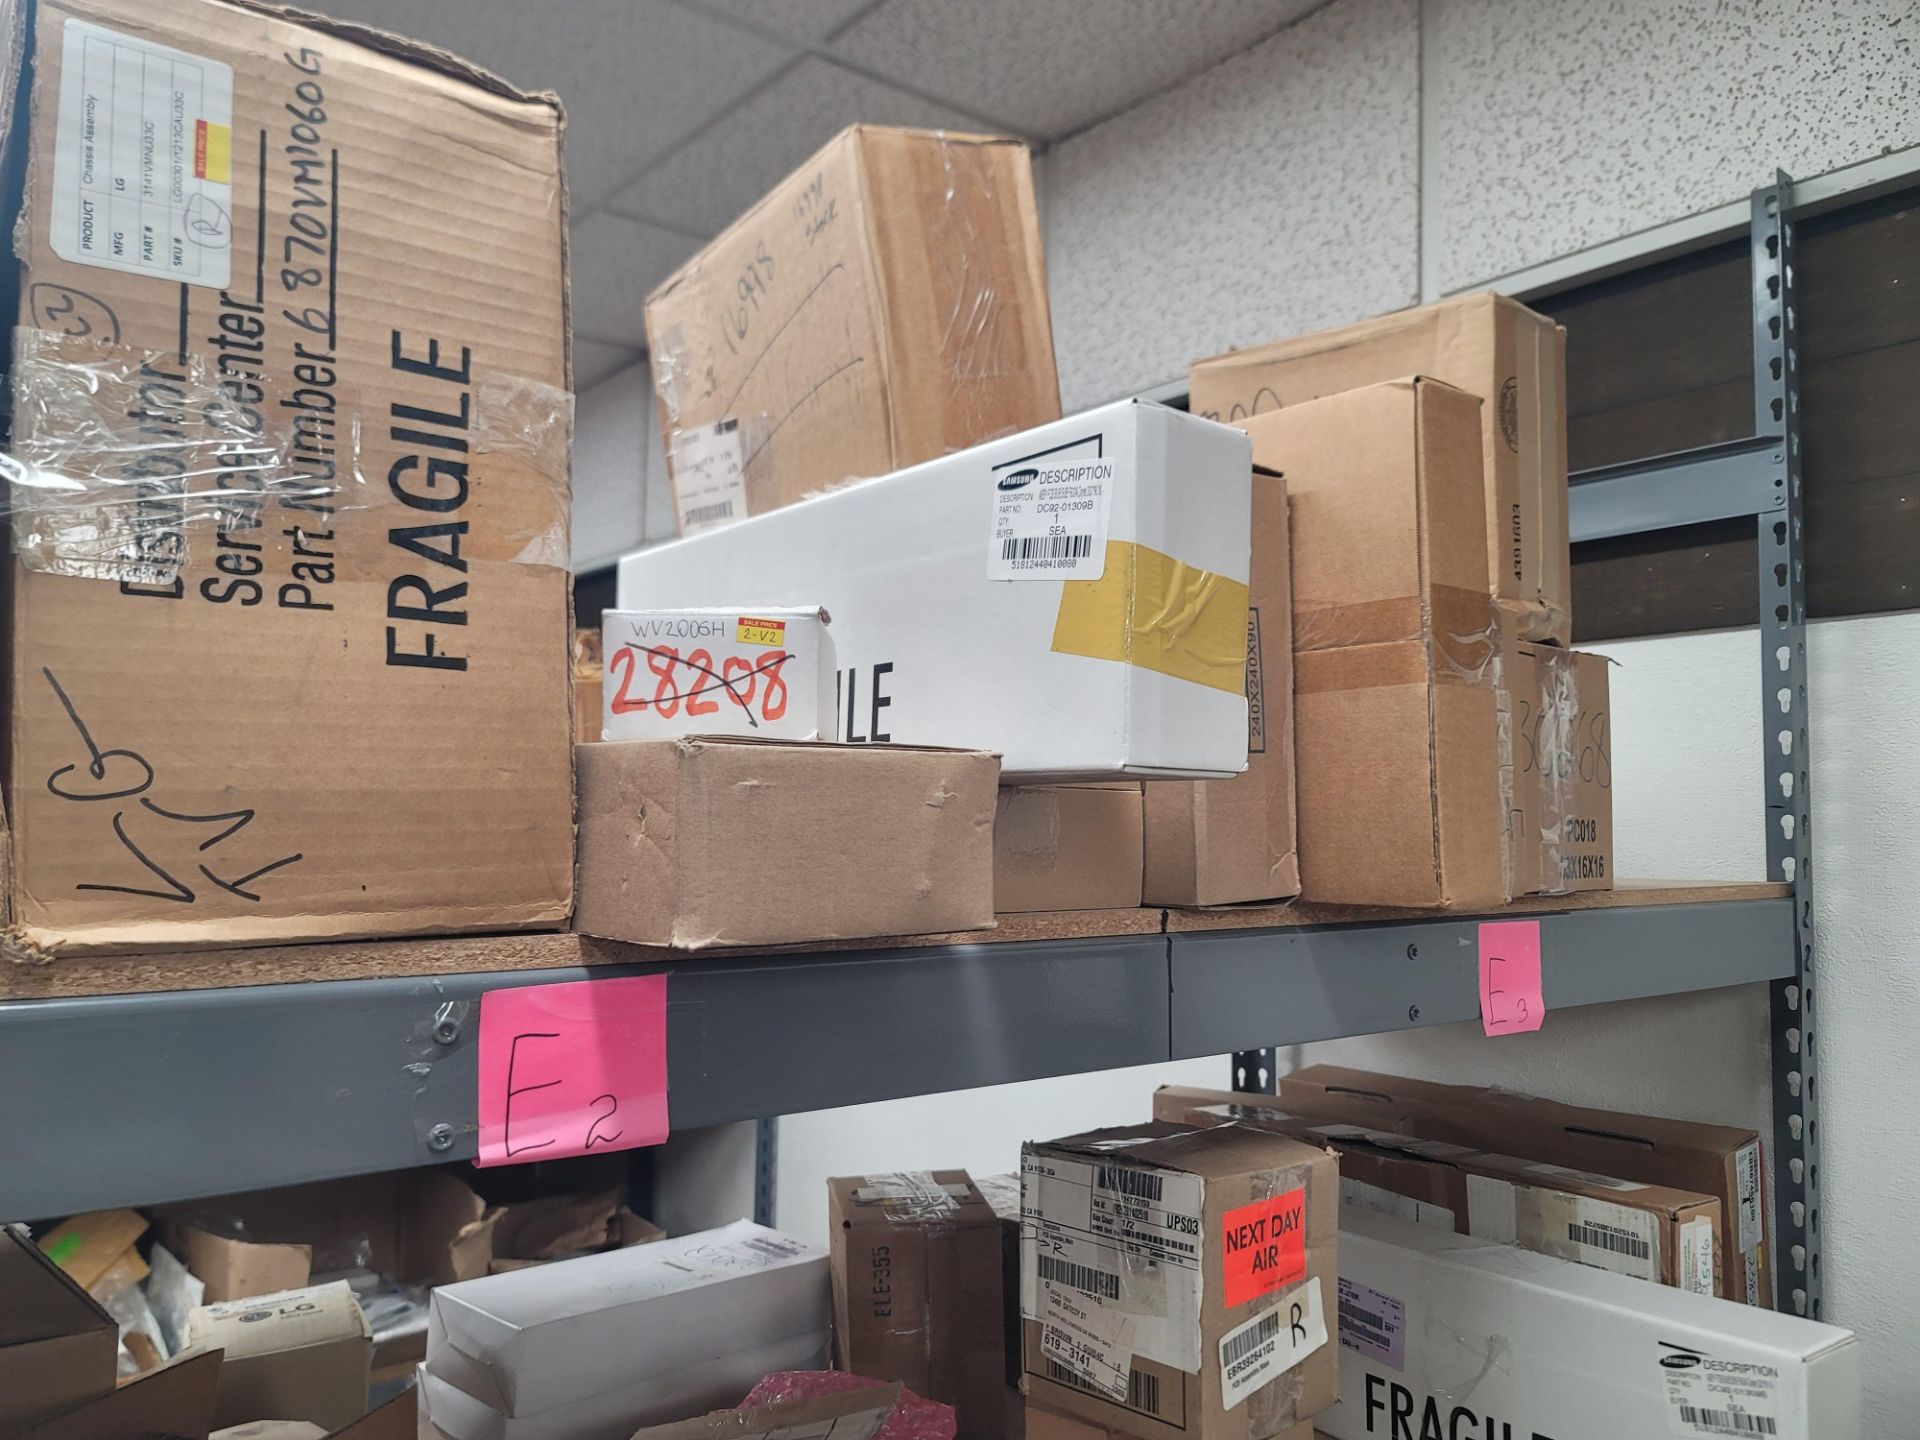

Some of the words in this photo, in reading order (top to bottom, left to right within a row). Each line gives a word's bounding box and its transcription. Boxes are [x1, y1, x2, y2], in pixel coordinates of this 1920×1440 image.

[83, 95, 98, 144] Assembly
[82, 146, 95, 184] Chassis
[114, 177, 126, 192] LG
[83, 200, 95, 250] PRODUCT
[113, 232, 124, 256] MFG
[143, 235, 154, 262] PART
[173, 247, 183, 267] SKU
[203, 291, 266, 436] Center
[280, 342, 337, 514] Number
[1001, 472, 1036, 487] SAMSUNG
[1038, 464, 1113, 485] DESCRIPTION
[386, 329, 471, 671] FRAGILE
[1036, 499, 1094, 514] DC92-01309B
[200, 447, 264, 606] Service
[1048, 525, 1067, 537] SEA
[1053, 513, 1059, 524] 1
[278, 525, 335, 611] Part
[743, 620, 760, 628] SALE
[760, 622, 778, 630] PRICE
[610, 644, 788, 722] 28208
[1247, 621, 1262, 737] 240X240X90
[1567, 819, 1597, 843] PC018
[1121, 1219, 1135, 1230] 1/2
[1166, 1213, 1199, 1235] UPS03
[1226, 1218, 1267, 1254] NEXT
[1271, 1205, 1301, 1238] DAY
[1251, 1245, 1279, 1275] AIR
[871, 1245, 892, 1318] ELE-355
[1290, 1302, 1307, 1349] R
[1702, 1359, 1779, 1378] DESCRIPTION
